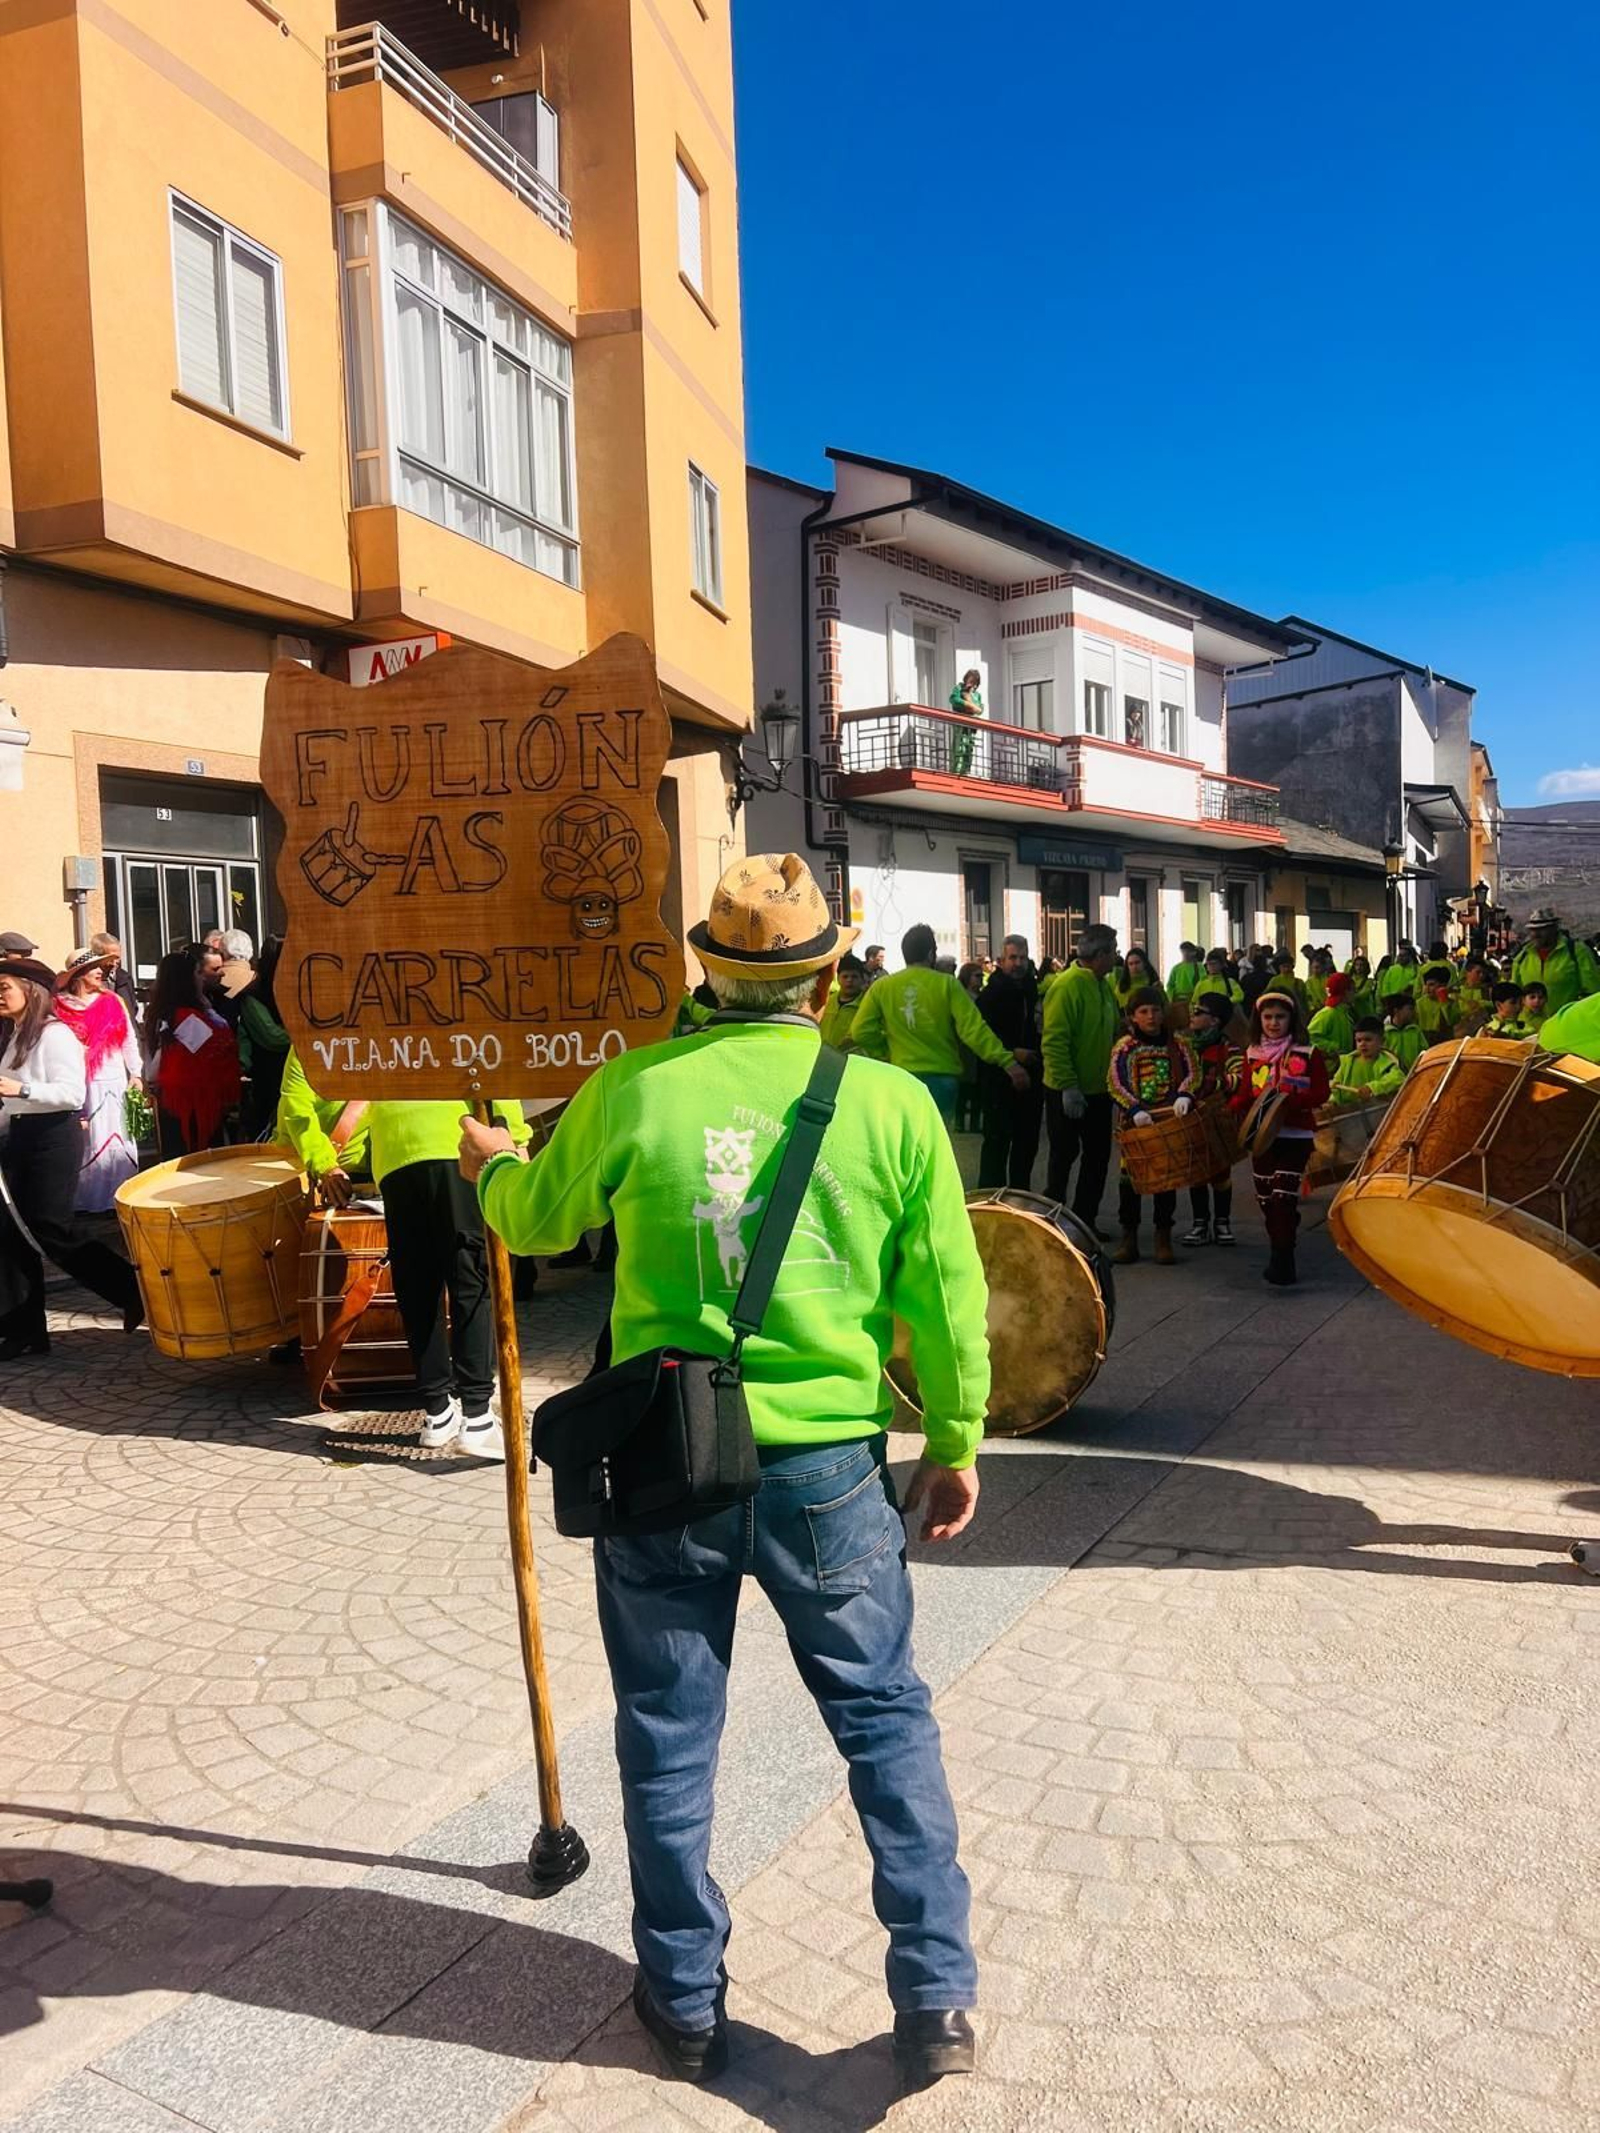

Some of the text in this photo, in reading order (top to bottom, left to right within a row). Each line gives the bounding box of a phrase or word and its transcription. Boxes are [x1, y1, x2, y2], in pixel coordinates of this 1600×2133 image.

[295, 687, 644, 805] FULIÓN
[158, 807, 171, 819] 53
[394, 811, 508, 895] AS
[298, 942, 668, 1028] CARRELAS
[313, 1029, 628, 1071] VIANA DO BOLO
